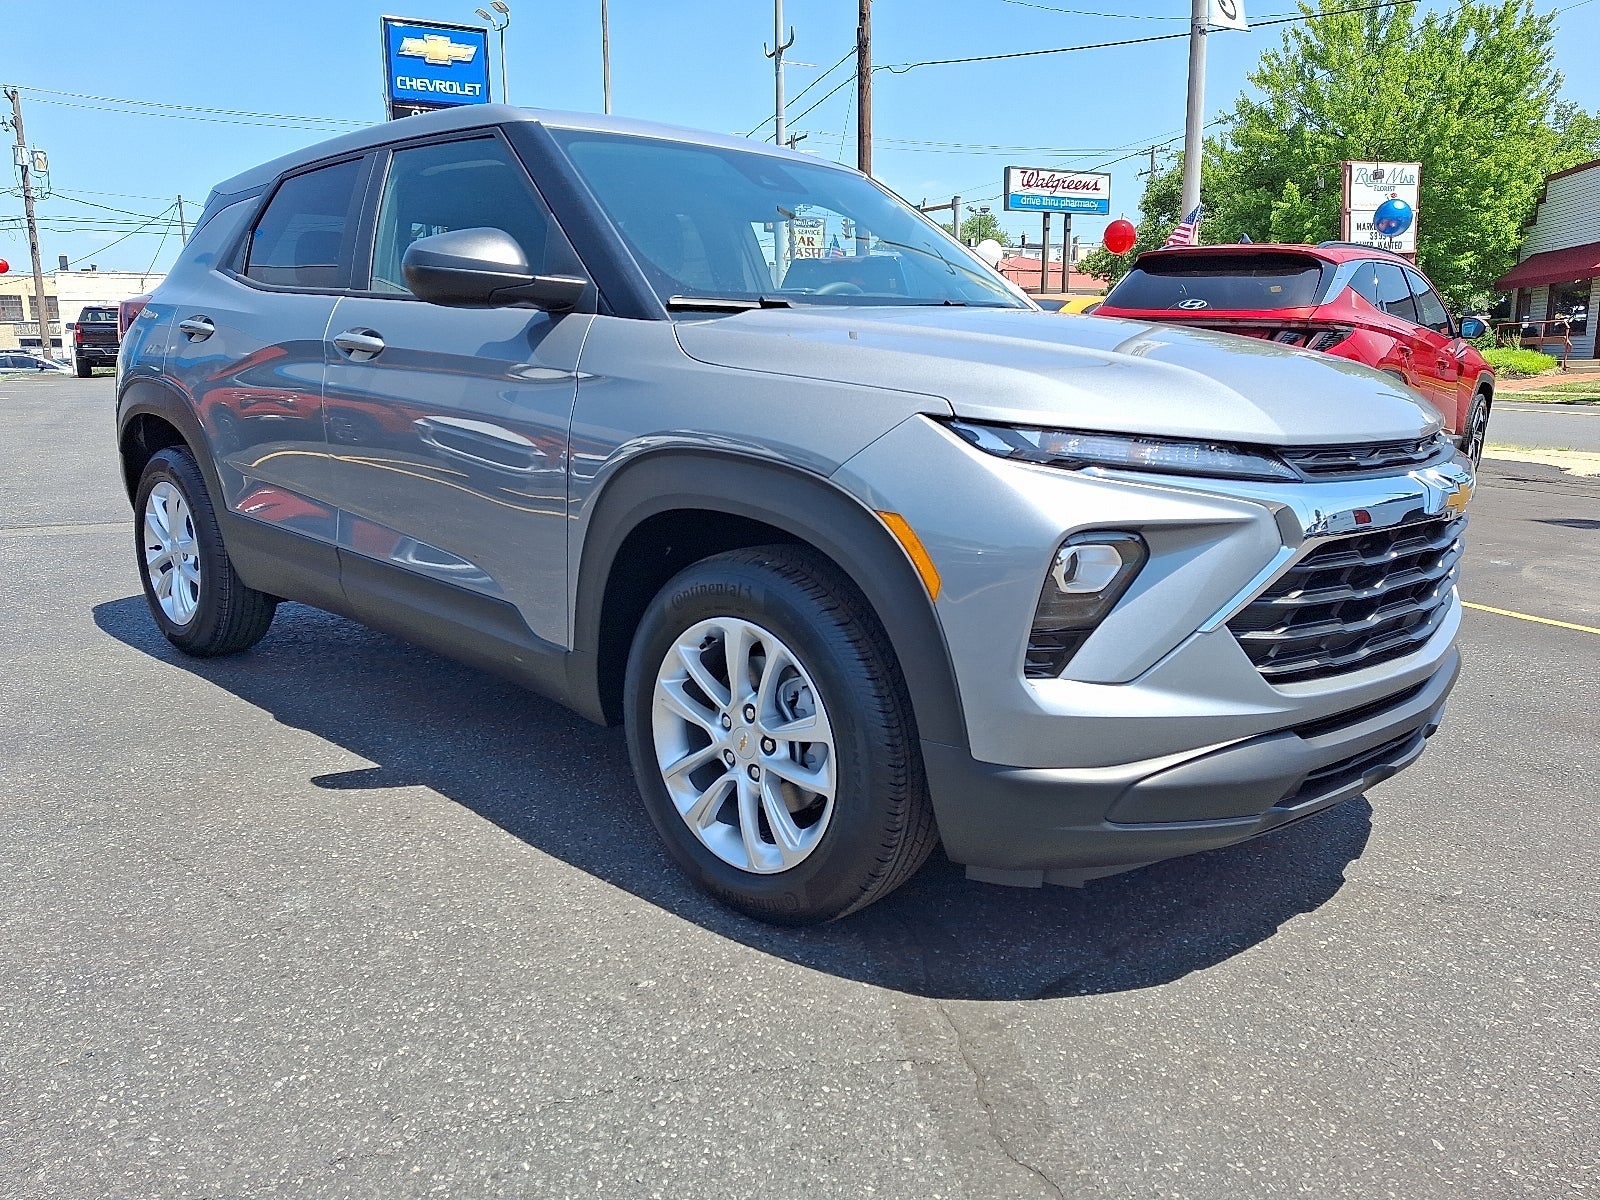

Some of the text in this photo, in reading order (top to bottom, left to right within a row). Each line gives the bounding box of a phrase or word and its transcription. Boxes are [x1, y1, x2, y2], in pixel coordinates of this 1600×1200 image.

[396, 76, 482, 96] CHEVROLET
[1019, 170, 1101, 195] Walgreens
[1020, 196, 1099, 211] drive thru pharmacy
